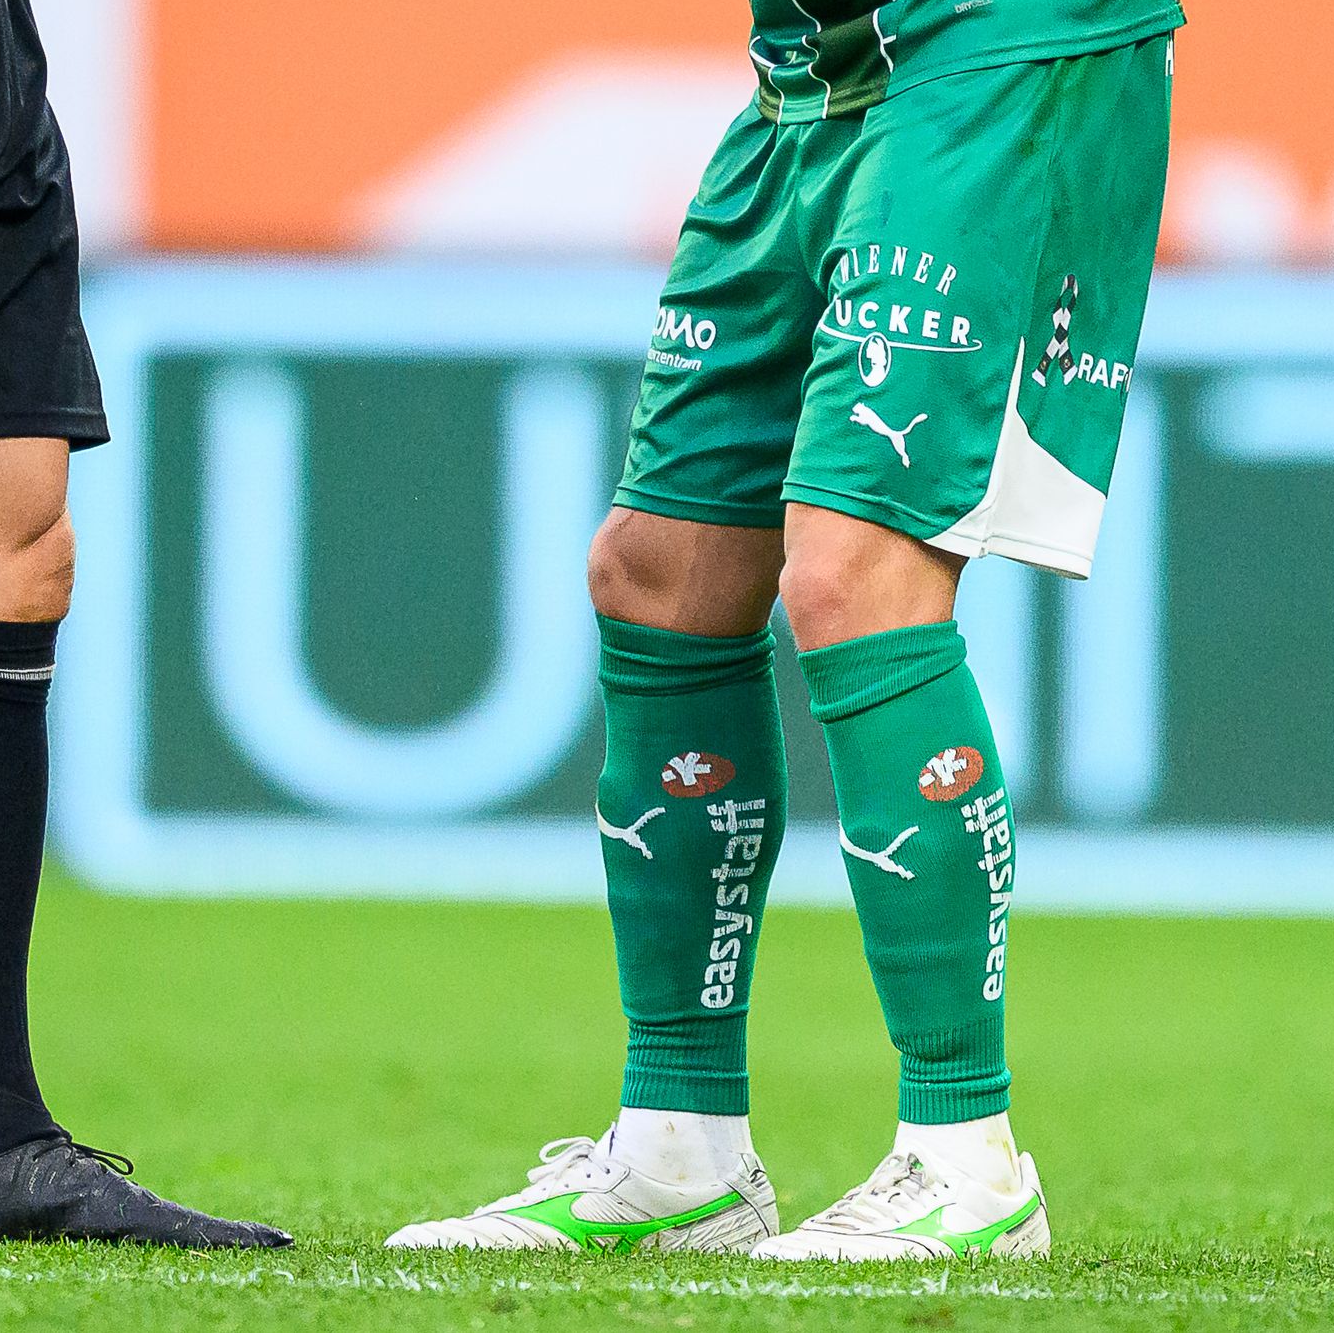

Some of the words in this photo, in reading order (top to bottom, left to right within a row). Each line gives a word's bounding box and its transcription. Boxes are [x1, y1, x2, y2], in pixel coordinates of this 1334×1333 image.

[834, 294, 971, 346] UCKER
[700, 798, 766, 1009] easystaff
[960, 786, 1013, 1002] easystaff
